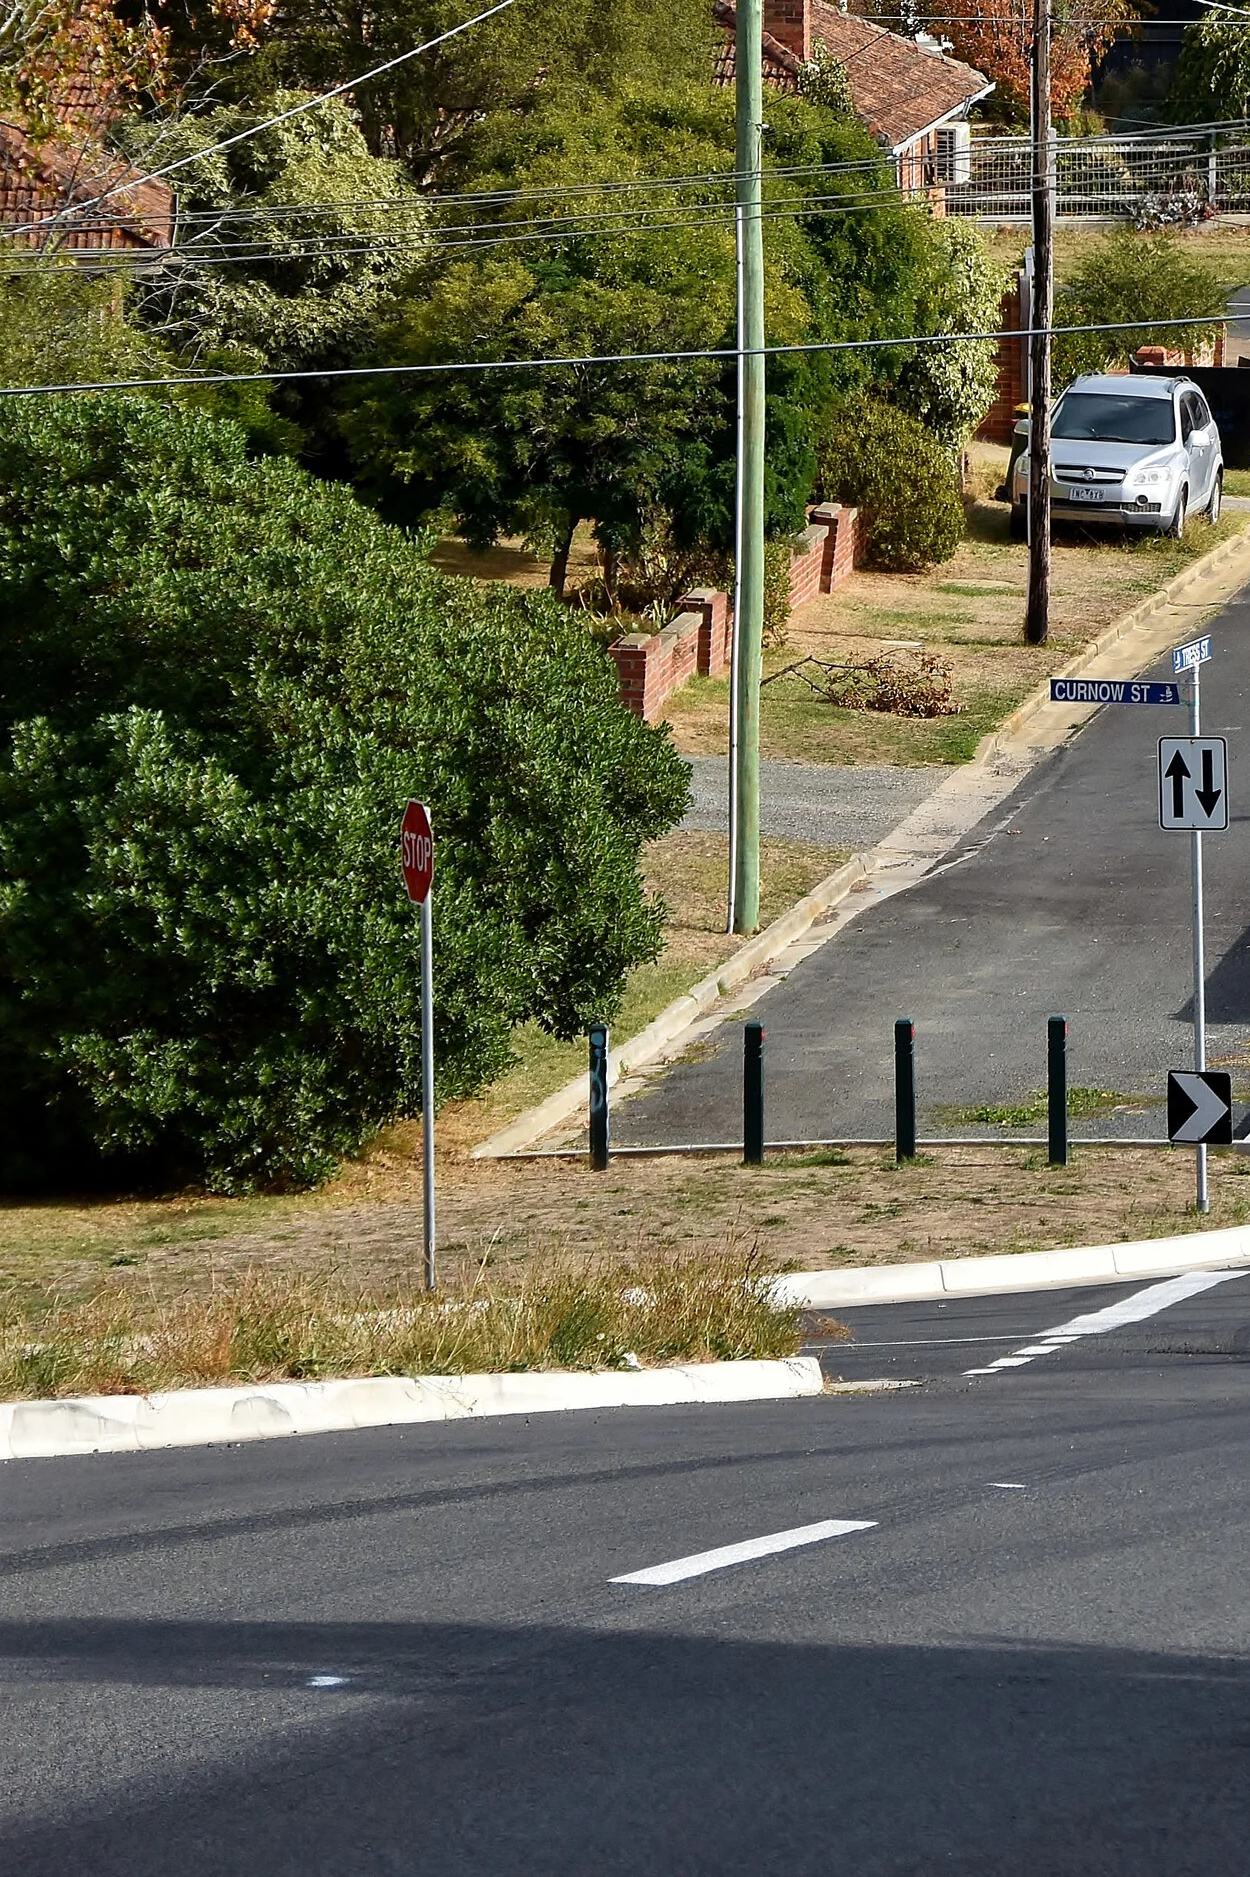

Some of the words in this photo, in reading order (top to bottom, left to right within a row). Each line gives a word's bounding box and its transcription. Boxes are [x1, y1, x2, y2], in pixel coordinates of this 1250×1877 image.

[1181, 642, 1200, 667] TRESS
[1200, 638, 1210, 659] ST
[1055, 682, 1125, 702] CURNOW
[1131, 684, 1150, 703] ST
[403, 830, 431, 873] STOP
